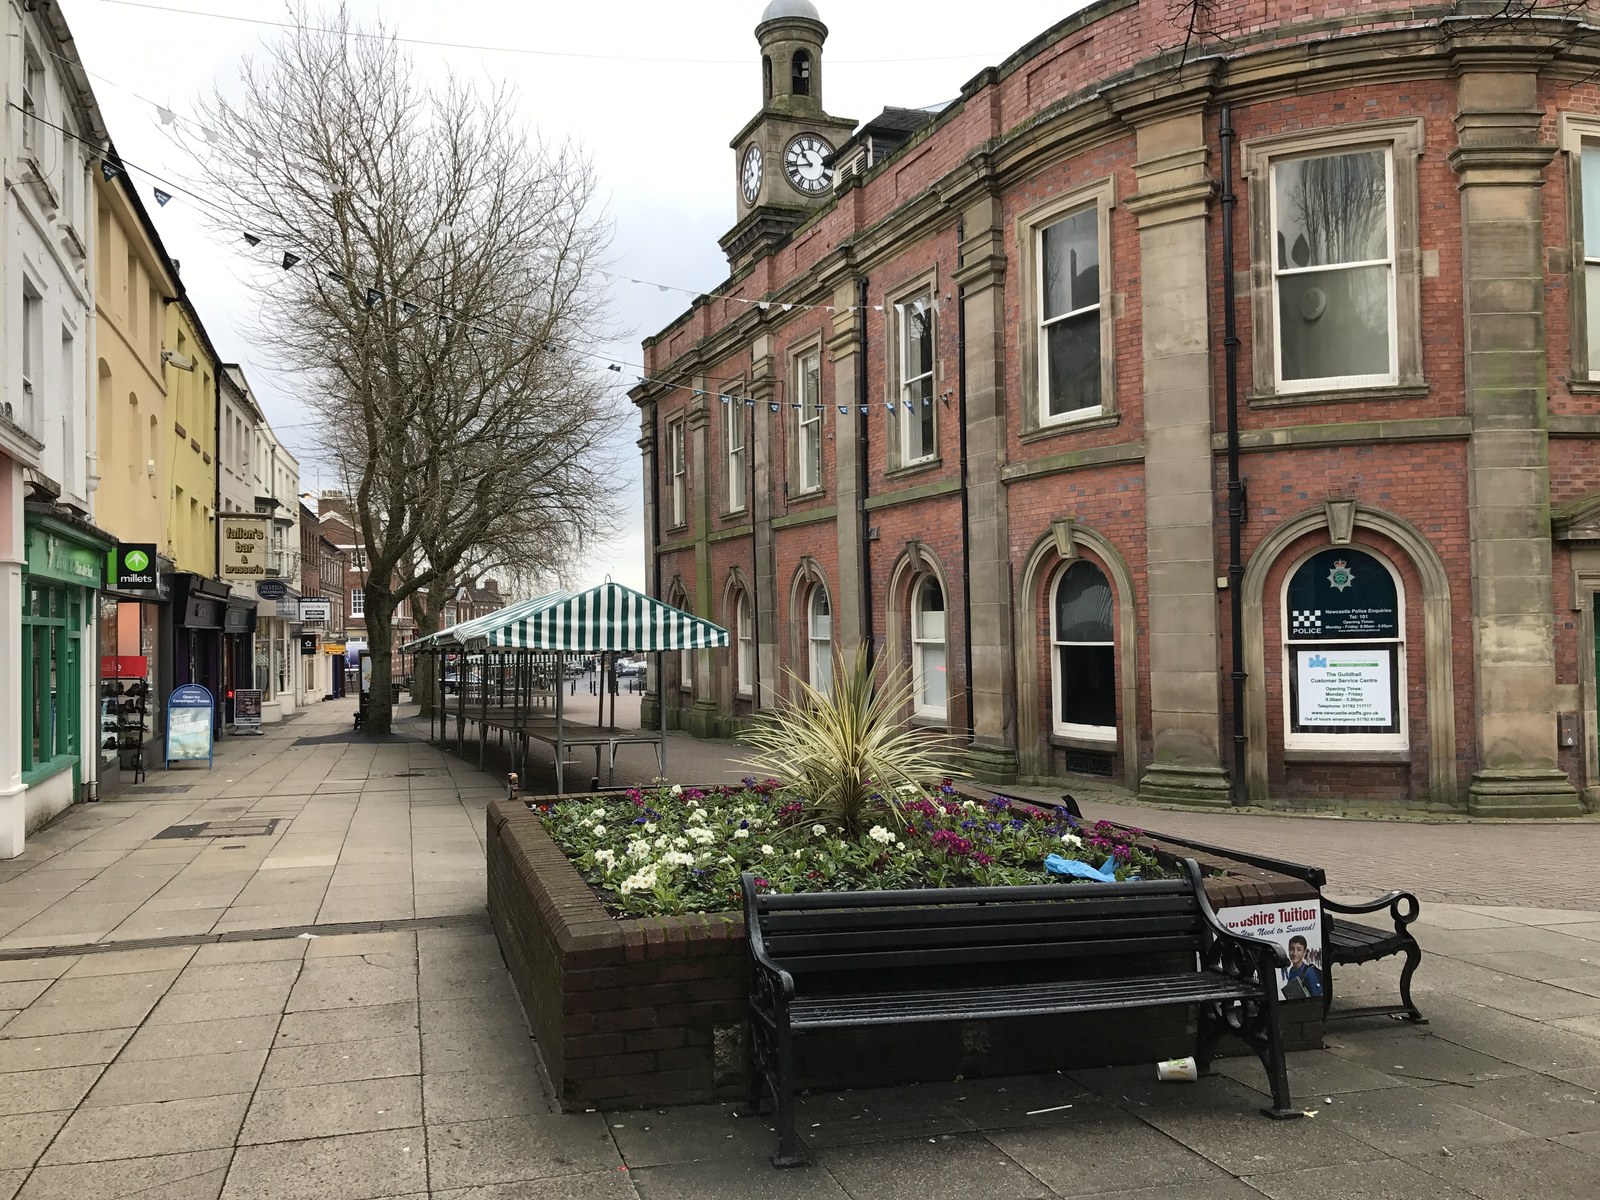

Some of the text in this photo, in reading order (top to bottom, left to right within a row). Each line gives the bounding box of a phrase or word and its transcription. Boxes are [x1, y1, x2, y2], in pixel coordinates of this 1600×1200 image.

[226, 527, 264, 540] fallon's
[235, 541, 254, 553] bar
[241, 555, 248, 564] &
[225, 565, 264, 574] brasserie
[120, 574, 152, 582] millets
[102, 660, 122, 672] ale
[1278, 907, 1317, 922] Tuition
[1257, 928, 1274, 936] Need
[1286, 923, 1316, 933] Succeed!
